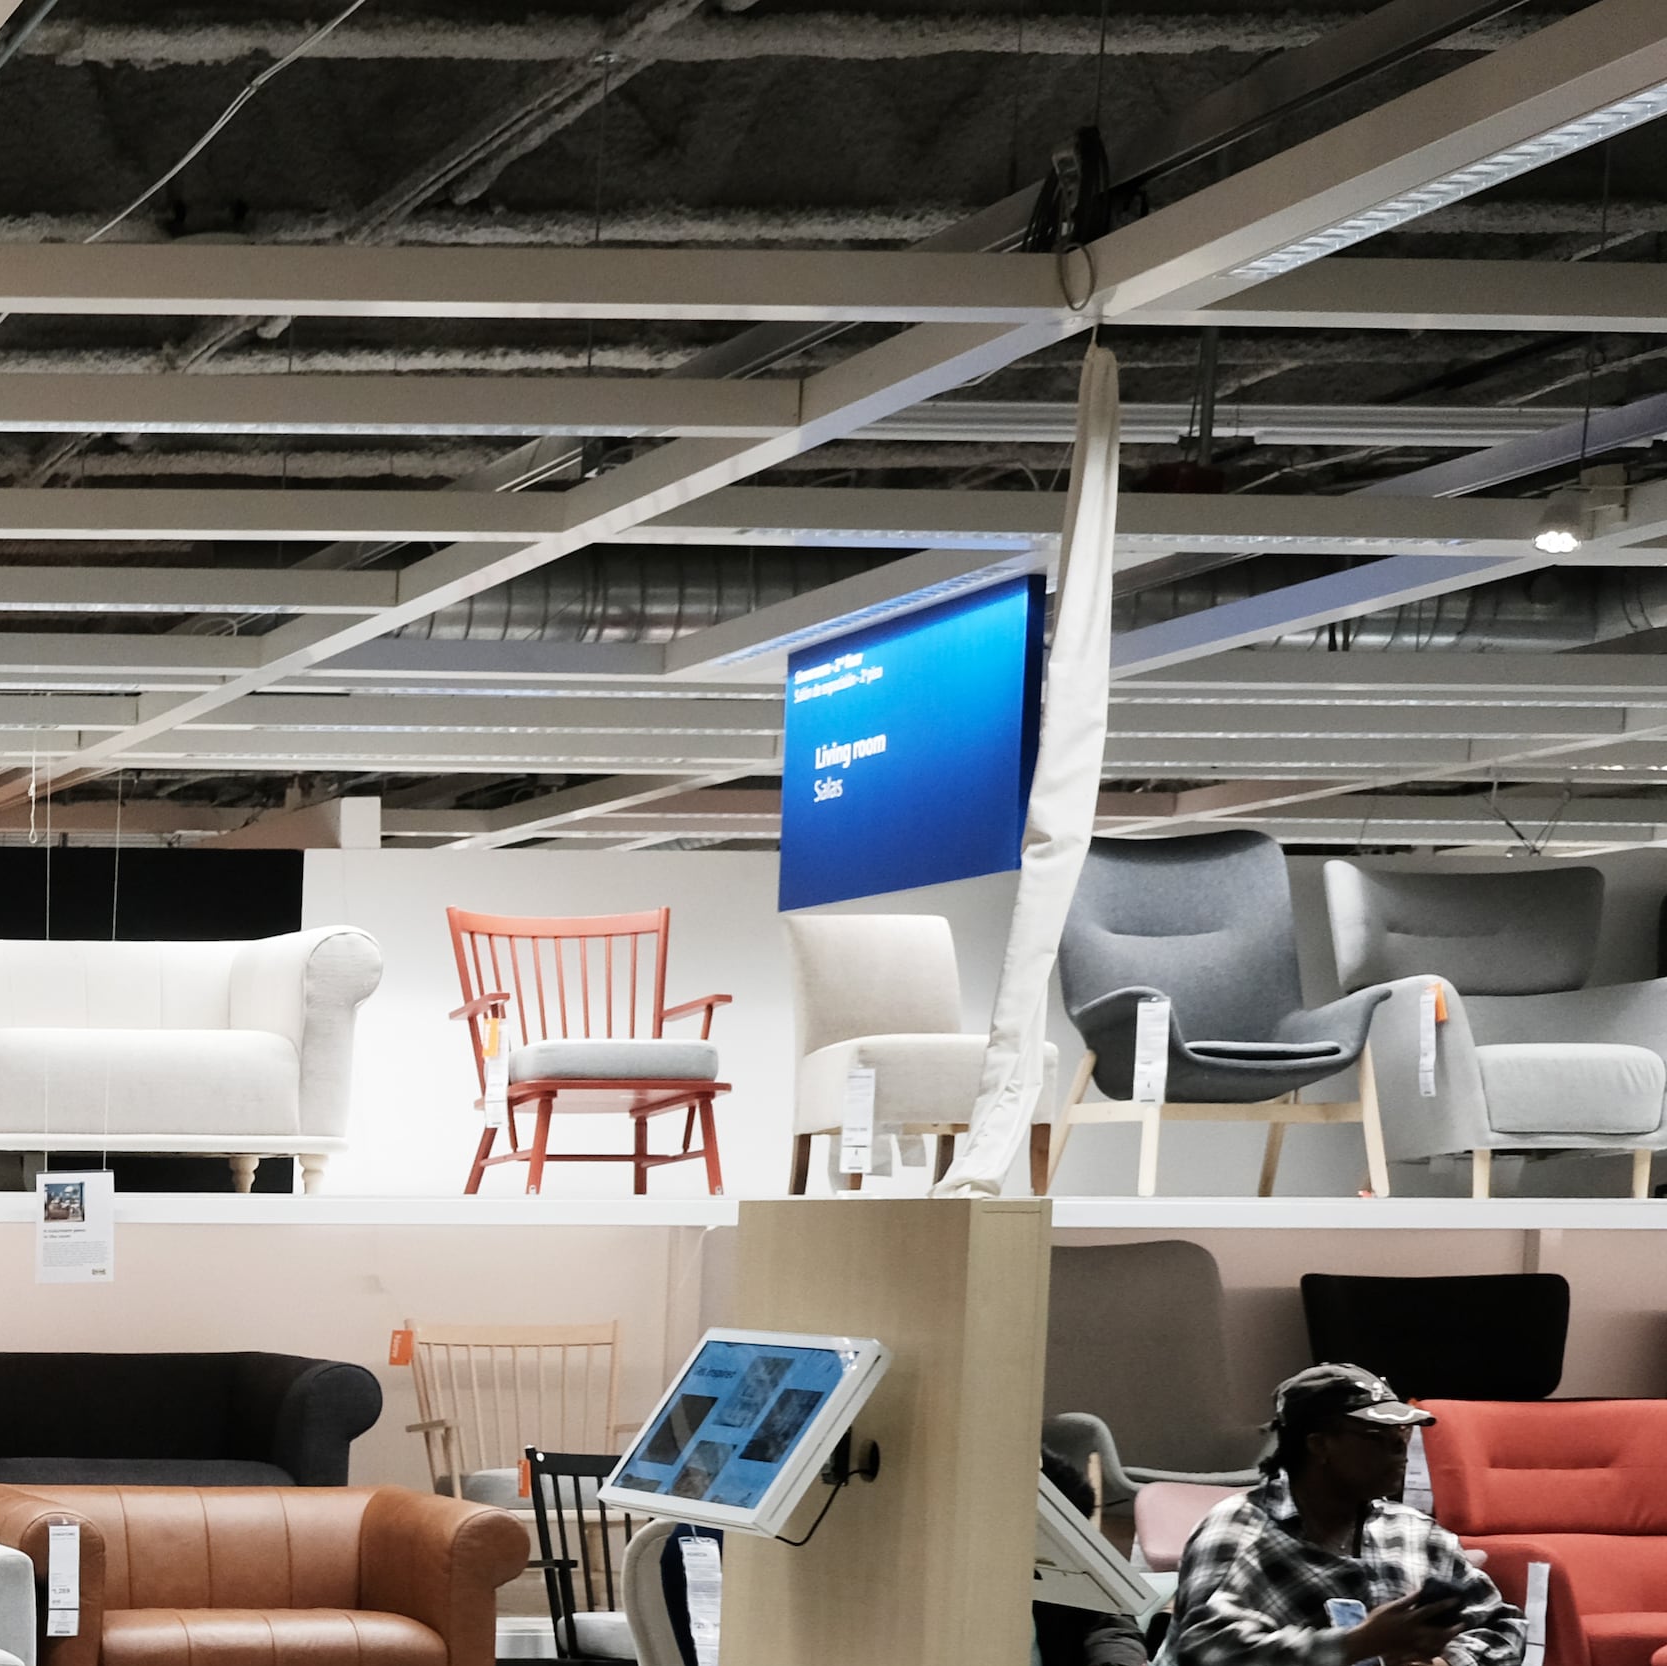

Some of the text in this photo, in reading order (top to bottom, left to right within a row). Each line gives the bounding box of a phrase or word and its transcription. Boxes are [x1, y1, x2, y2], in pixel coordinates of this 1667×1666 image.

[814, 733, 887, 770] Living room
[813, 776, 844, 803] Salas
